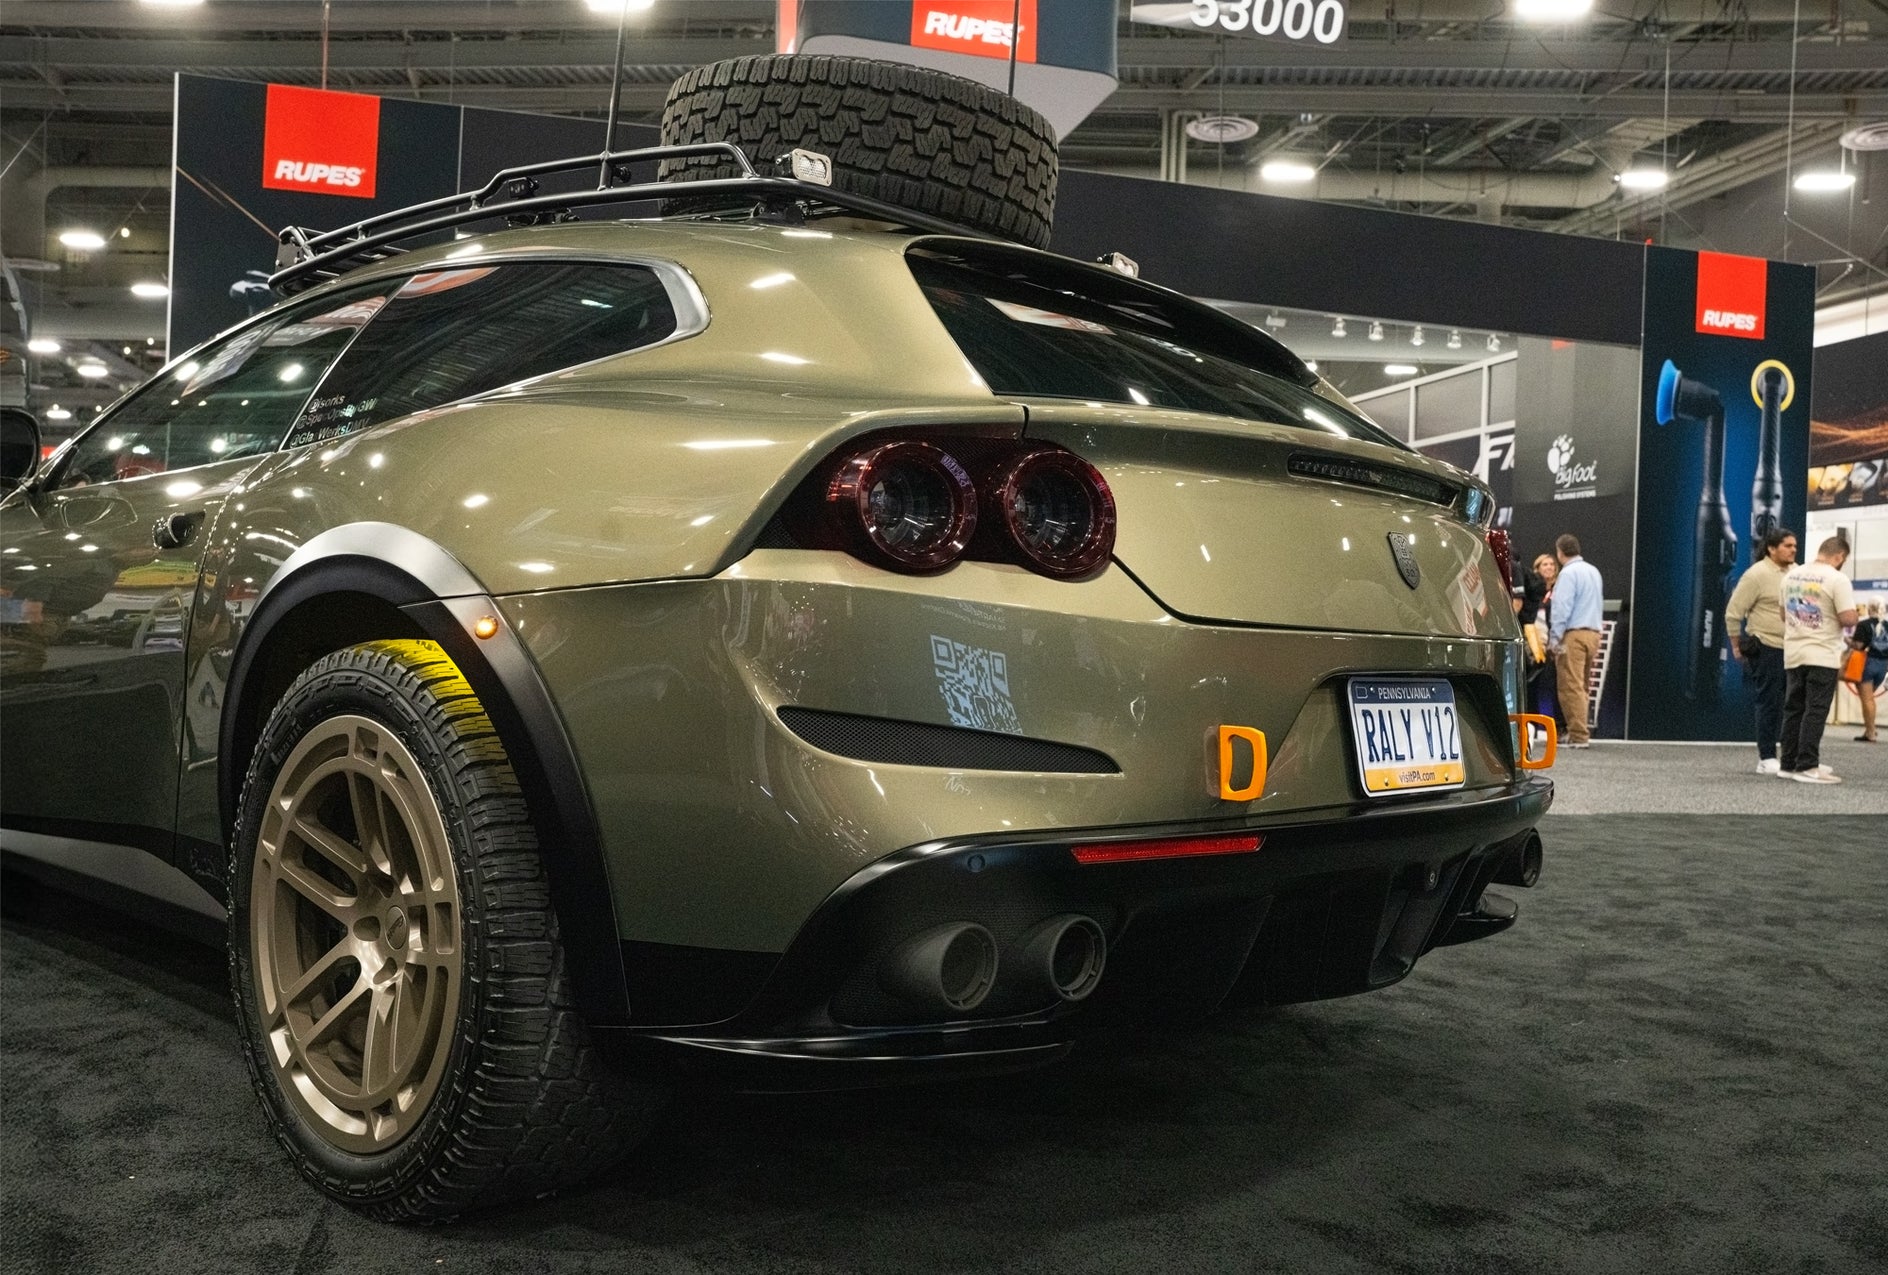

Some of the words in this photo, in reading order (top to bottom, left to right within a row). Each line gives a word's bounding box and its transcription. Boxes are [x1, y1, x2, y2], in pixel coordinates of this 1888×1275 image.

[924, 10, 1020, 47] RUPES
[1190, 0, 1344, 44] 53000
[274, 159, 362, 187] RUPES
[1702, 309, 1757, 332] RUPES
[1378, 687, 1431, 700] PENNSYLVANIA
[1361, 708, 1413, 762] RALY
[1421, 706, 1459, 760] V12
[1399, 770, 1436, 783] visitPA.com
